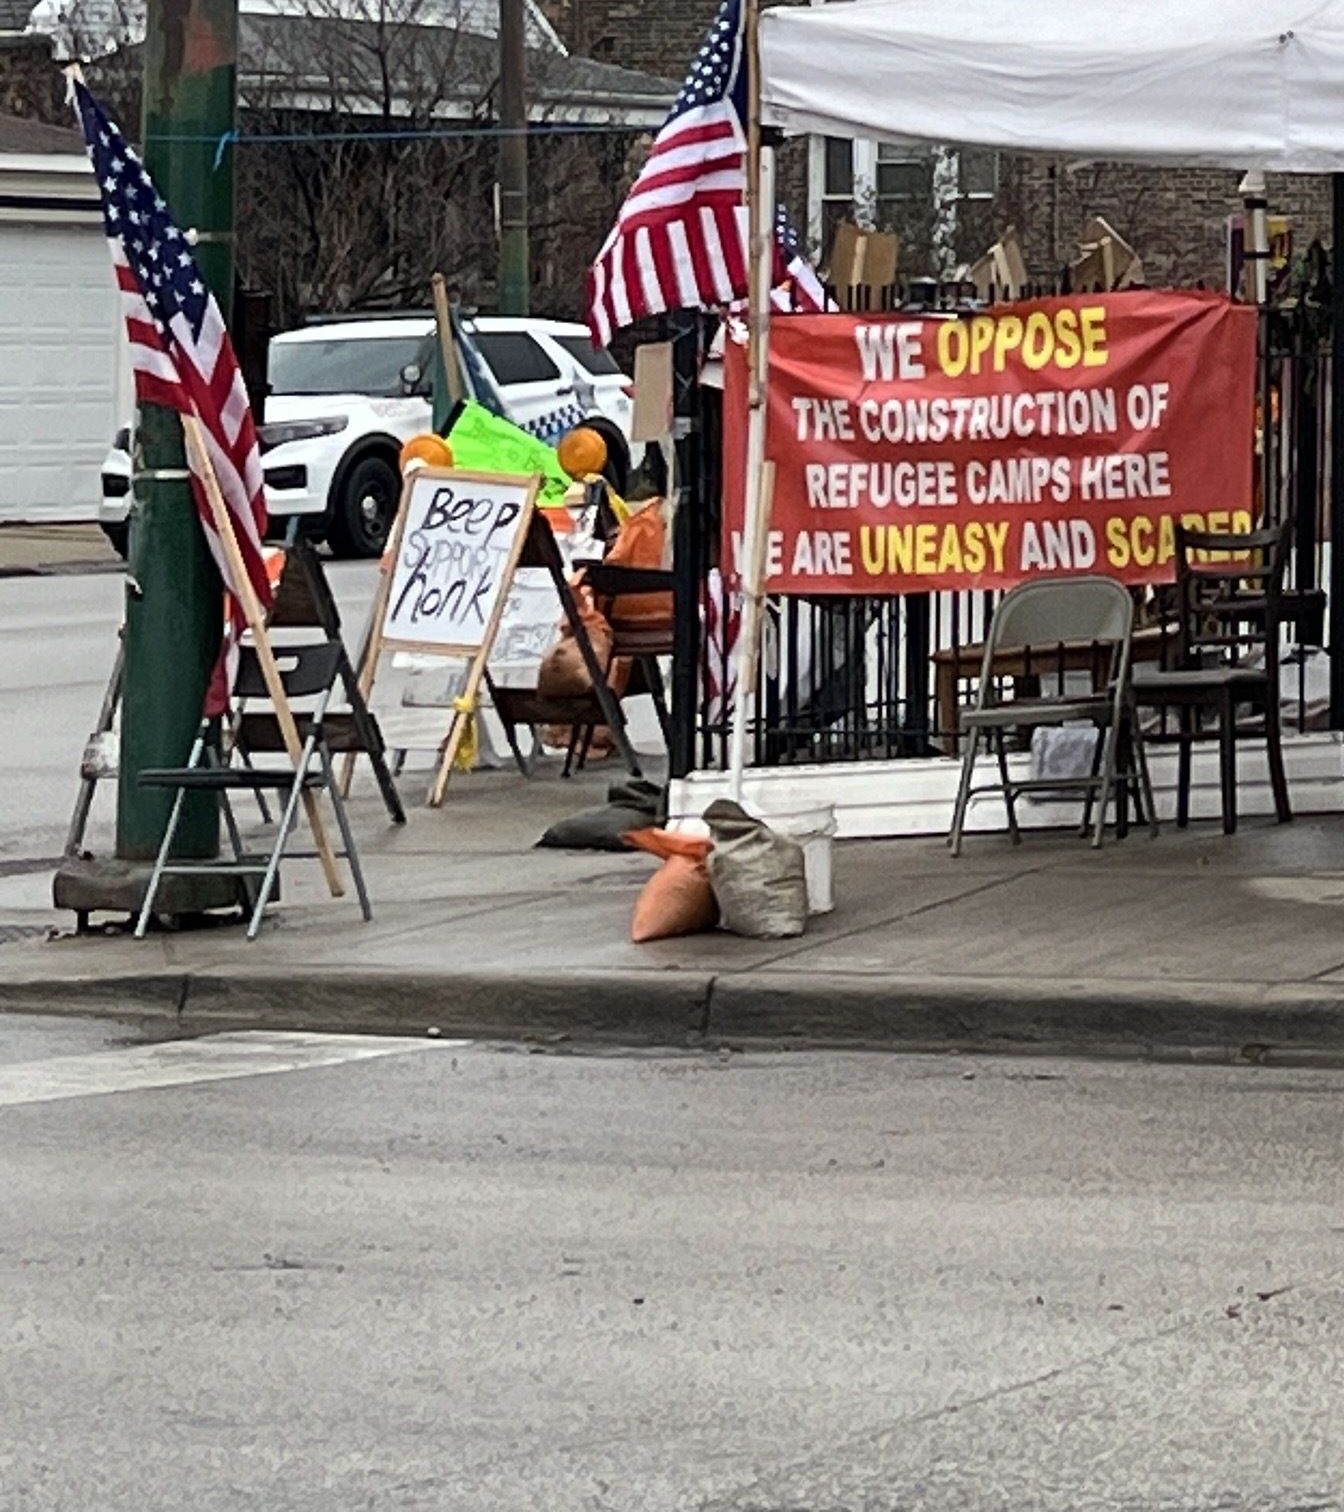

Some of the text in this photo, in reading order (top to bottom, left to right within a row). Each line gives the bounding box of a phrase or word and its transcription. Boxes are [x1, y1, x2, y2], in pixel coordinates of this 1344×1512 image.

[854, 305, 1110, 383] WE OPPOSE
[792, 382, 1170, 444] THE CONSTRUCTION OF
[805, 451, 1172, 510] REFUGEE CAMPS HERE
[420, 486, 521, 548] Beep
[791, 530, 854, 576] ARE
[859, 521, 1013, 576] UNEASY
[1020, 518, 1096, 572] AND
